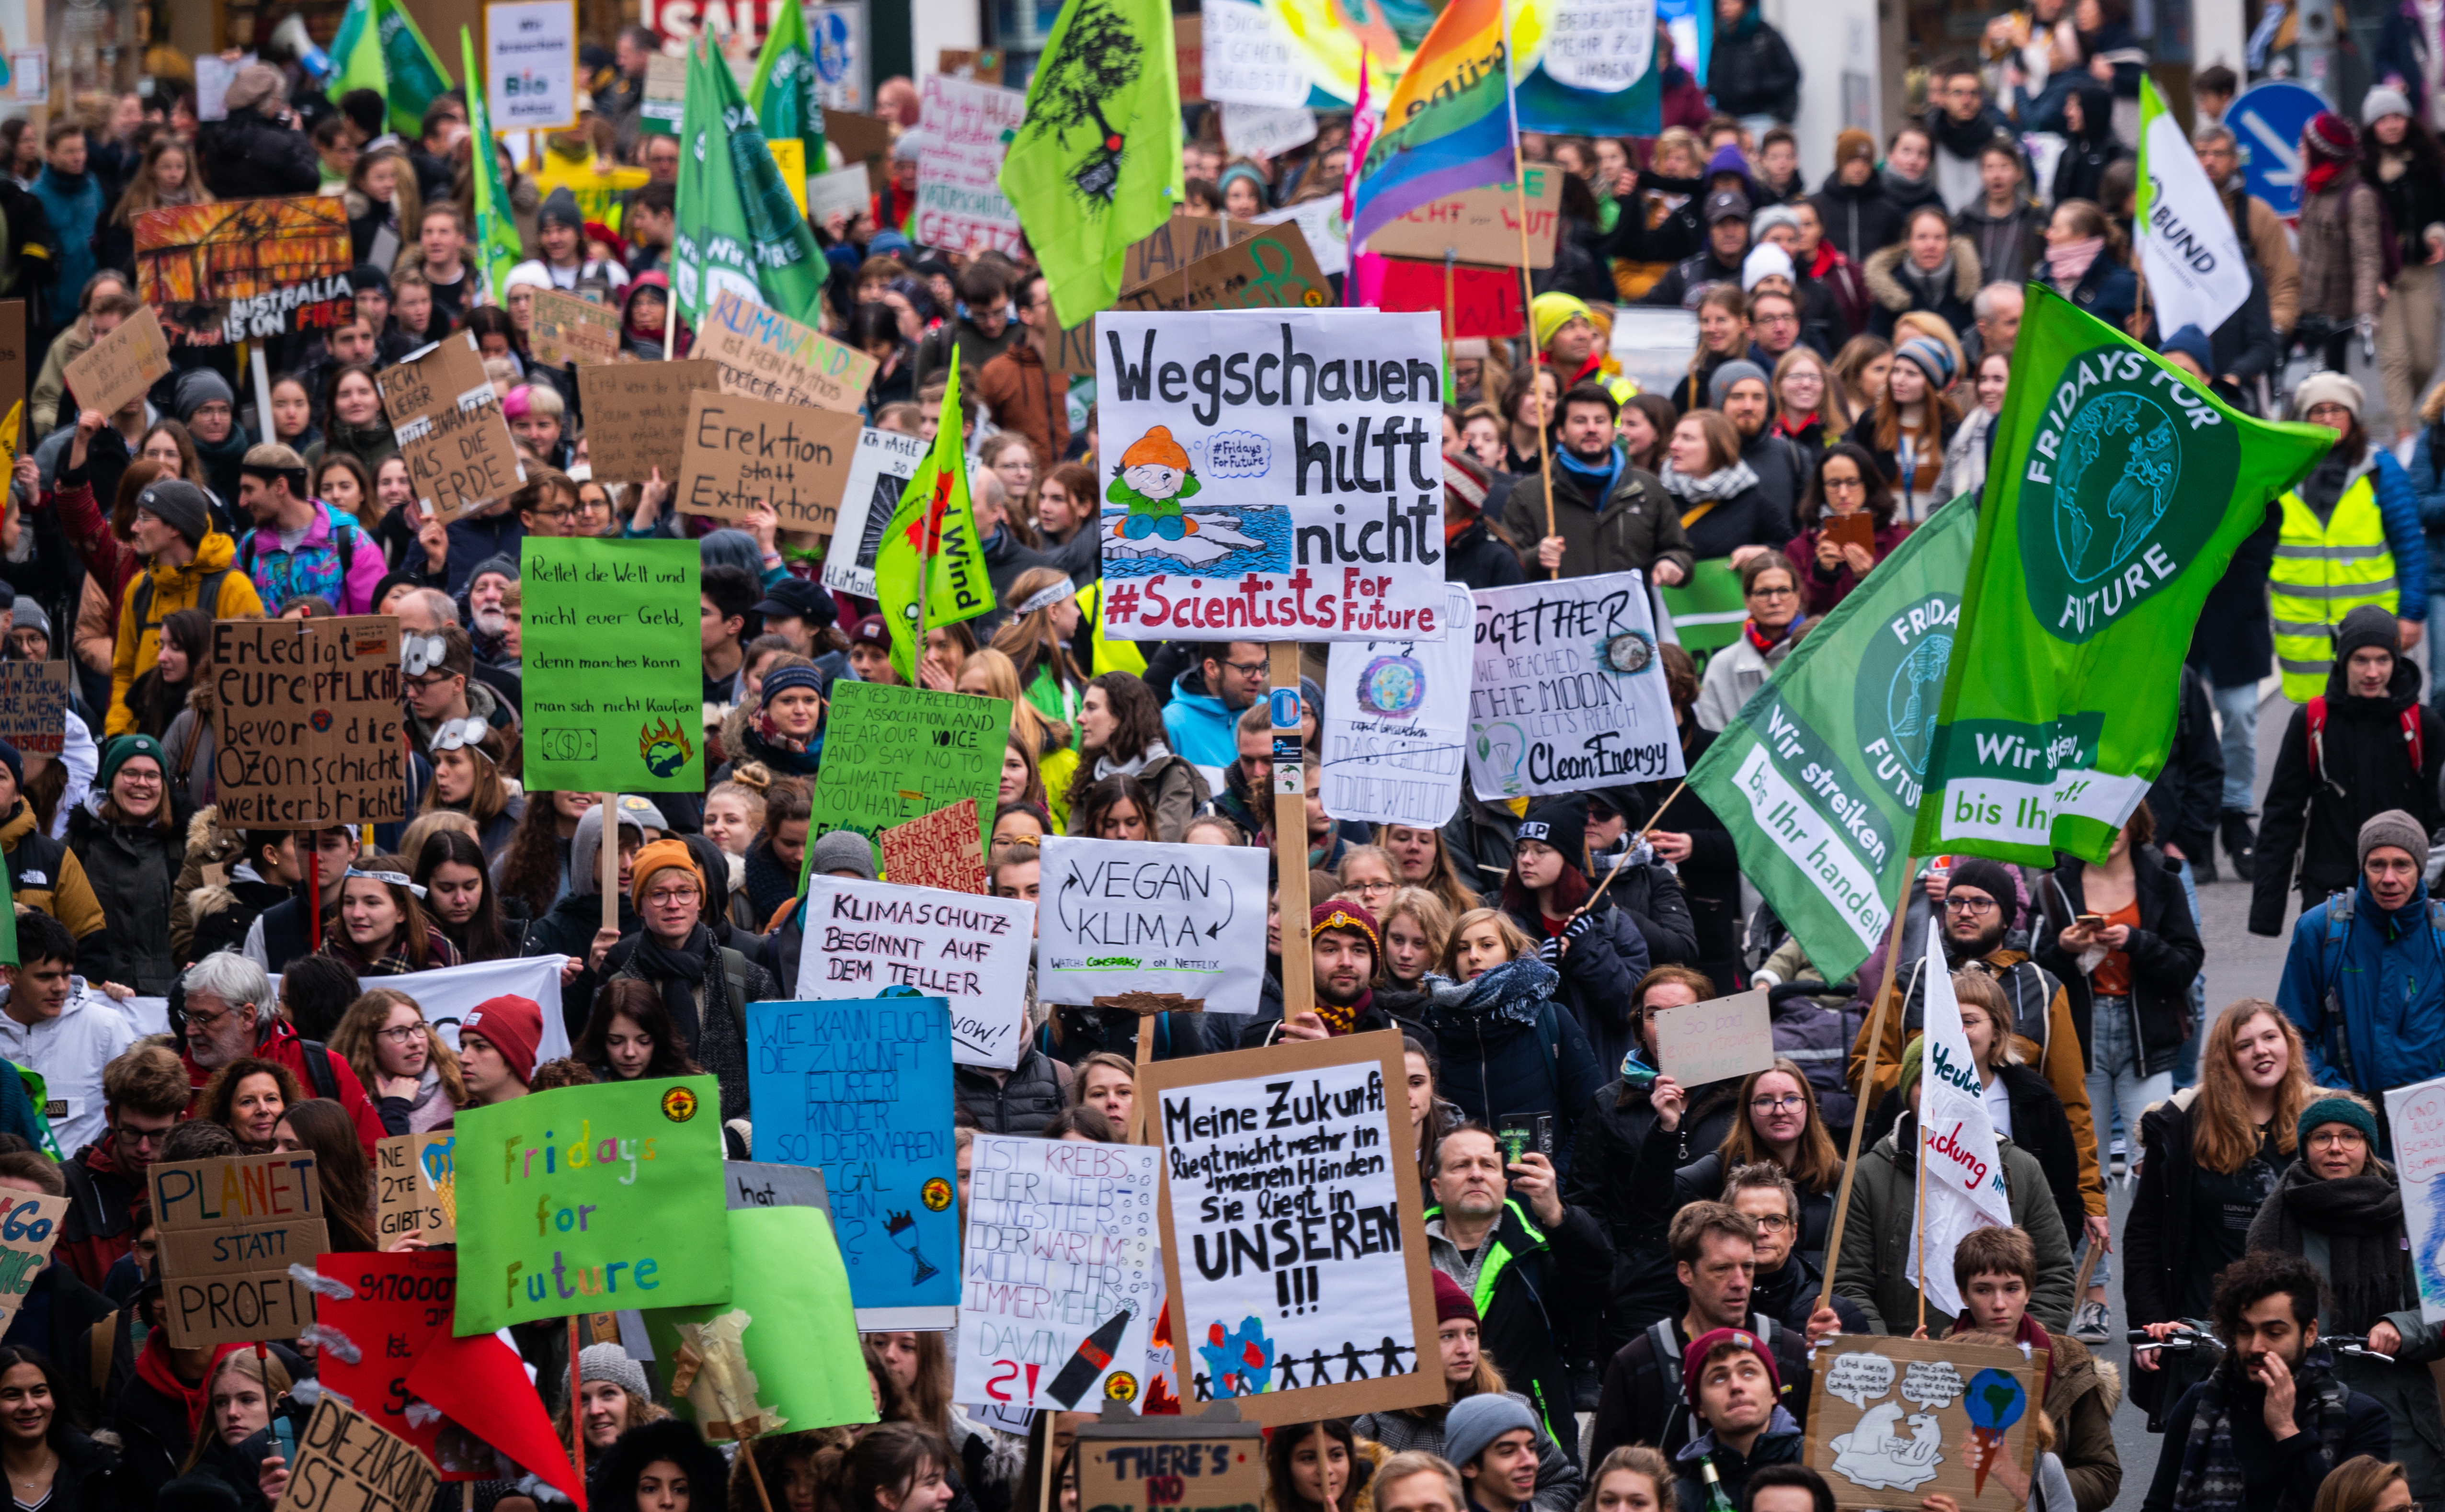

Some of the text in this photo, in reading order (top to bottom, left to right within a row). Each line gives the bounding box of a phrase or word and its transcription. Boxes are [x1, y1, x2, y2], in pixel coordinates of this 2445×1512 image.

[2153, 205, 2216, 274] BUND
[230, 274, 353, 320] AUSTRALIA
[251, 311, 285, 335] ON
[296, 299, 354, 331] FIRE
[713, 293, 871, 390] KLIMAWANDEL
[1107, 322, 1439, 426] Wegschauen
[2027, 350, 2221, 485] FRIDAYS FOR
[414, 426, 489, 479] ALS DIE
[698, 409, 833, 466] Erektion
[1213, 441, 1261, 457] #Fridays
[1293, 416, 1438, 495] hilft
[434, 455, 505, 512] ERDE
[741, 462, 795, 482] statt
[691, 475, 837, 523] Extinktion
[1297, 494, 1440, 565] nicht
[532, 556, 685, 584] Rettet die Welt und
[942, 526, 981, 612] Wind
[1342, 567, 1392, 599] For
[2059, 543, 2177, 634] FUTURE
[532, 605, 683, 628] nicht euer Geld,
[1105, 568, 1337, 629] #Scientists
[1342, 600, 1435, 632] Future
[214, 621, 354, 669] Erledigt
[533, 651, 574, 670] denn
[579, 656, 638, 669] manches
[1477, 649, 1580, 682] WE REACHED
[218, 668, 306, 707] eure
[534, 696, 640, 713] man sich nicht
[837, 685, 992, 712] SAY YES TO FREEDOM
[1471, 671, 1623, 719] THE MOON
[224, 708, 396, 746] bevor die
[829, 724, 978, 748] HEAR OUR VOICE
[833, 705, 994, 732] OF ASSOCIATION AND
[1530, 702, 1638, 739] LET'S REACH
[217, 747, 403, 788] Ozonschicht
[827, 745, 983, 773] AND SAY NO TO
[1332, 735, 1460, 776] DAS GELD
[1975, 732, 2042, 771] Wir
[820, 766, 994, 799] CLIMATE CHANGE
[1331, 774, 1450, 823] DIE WELT
[1767, 704, 1885, 875] Wir streiken,
[220, 786, 404, 822] weiterbricht!
[819, 787, 912, 818] YOU HAVE
[1748, 761, 1808, 845] bis Ihr
[1954, 790, 2000, 825] bis
[1070, 860, 1210, 900] VEGAN
[833, 893, 1011, 935] KLIMASCHUTZ
[1078, 908, 1199, 947] KLIMA
[822, 927, 993, 963] BEGINNT AUF
[827, 956, 983, 998] DEM TELLER
[756, 1010, 942, 1045] WIE KANN EUCH
[760, 1041, 927, 1074] DIE ZUKUNFT
[1931, 1041, 1984, 1099] Heute
[809, 1072, 897, 1102] EURER
[1164, 1071, 1384, 1145] Meine Zukunft
[505, 1121, 656, 1185] Fridays
[777, 1134, 809, 1161] SO
[981, 1140, 1129, 1179] IST KREBS
[1171, 1125, 1379, 1189] liegt nicht mehr in
[157, 1160, 314, 1222] PLANET
[381, 1175, 416, 1204] 2TE
[738, 1178, 776, 1206] hat
[973, 1170, 1040, 1203] EUER
[1215, 1164, 1293, 1194] meinen
[381, 1207, 442, 1234] GIBT'S
[536, 1194, 597, 1237] for
[971, 1201, 1116, 1236] LINGSTIER
[1200, 1186, 1355, 1224] Sie liegt in
[213, 1230, 287, 1262] STATT
[970, 1223, 1123, 1266] ODER WARUM
[1193, 1202, 1401, 1281] UNSEREN
[507, 1251, 660, 1308] Future
[970, 1249, 1122, 1302] WOLLT IHR
[1276, 1266, 1319, 1319] !!!
[965, 1281, 1114, 1327] IMMER MEHR
[980, 1321, 1065, 1368] DAVON
[308, 1398, 364, 1466] DIE
[1106, 1444, 1229, 1481] THERE'S
[1146, 1476, 1184, 1505] NO
